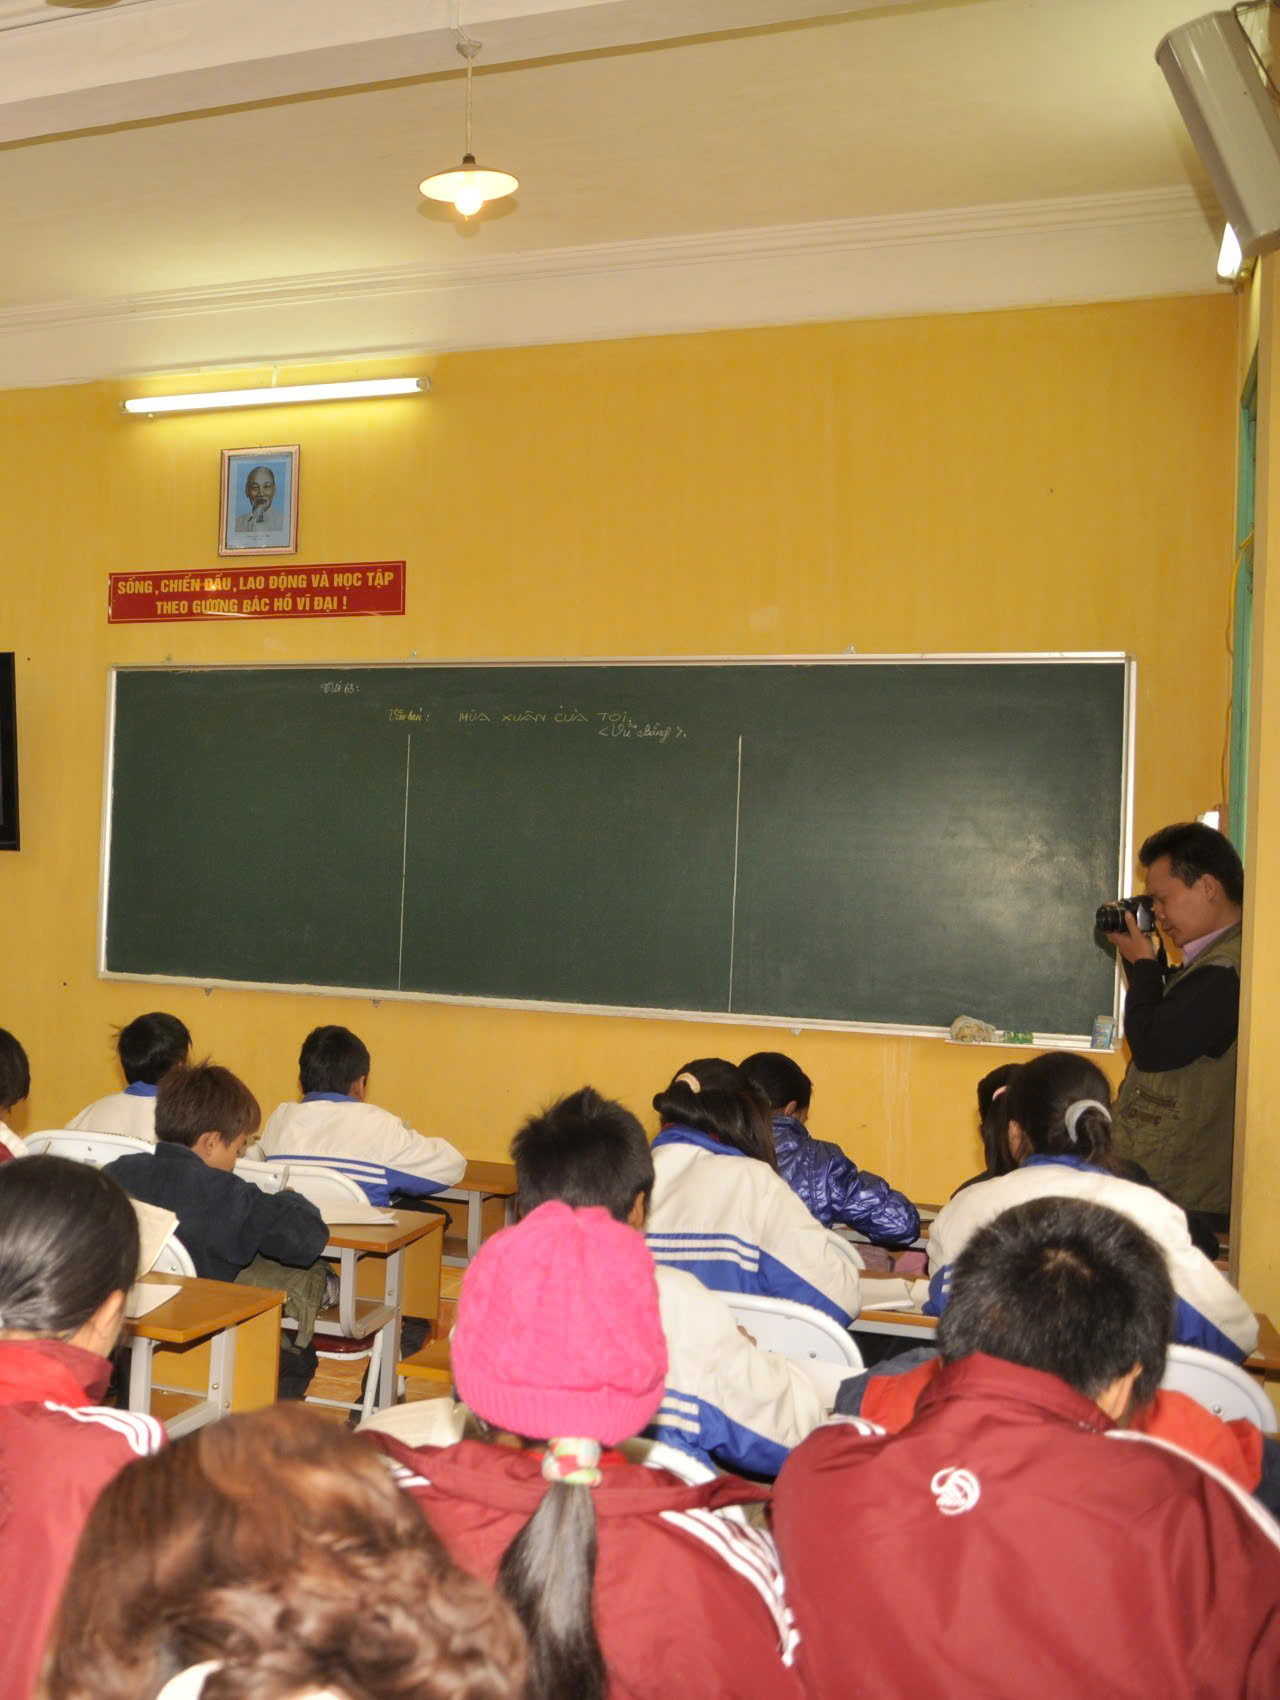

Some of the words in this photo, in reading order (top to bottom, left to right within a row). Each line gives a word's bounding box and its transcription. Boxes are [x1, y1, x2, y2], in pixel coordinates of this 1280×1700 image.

[160, 574, 200, 592] CHIẾN
[239, 575, 265, 590] LAO
[268, 572, 307, 591] ĐỘNG
[311, 571, 330, 588] VÀ
[333, 572, 362, 590] HỌC
[366, 569, 394, 588] TẬP
[155, 600, 188, 614] THEO
[242, 595, 270, 612] BÁC
[273, 593, 292, 611] HỒ
[296, 594, 311, 610] VĨ
[502, 709, 546, 722] XUÂN
